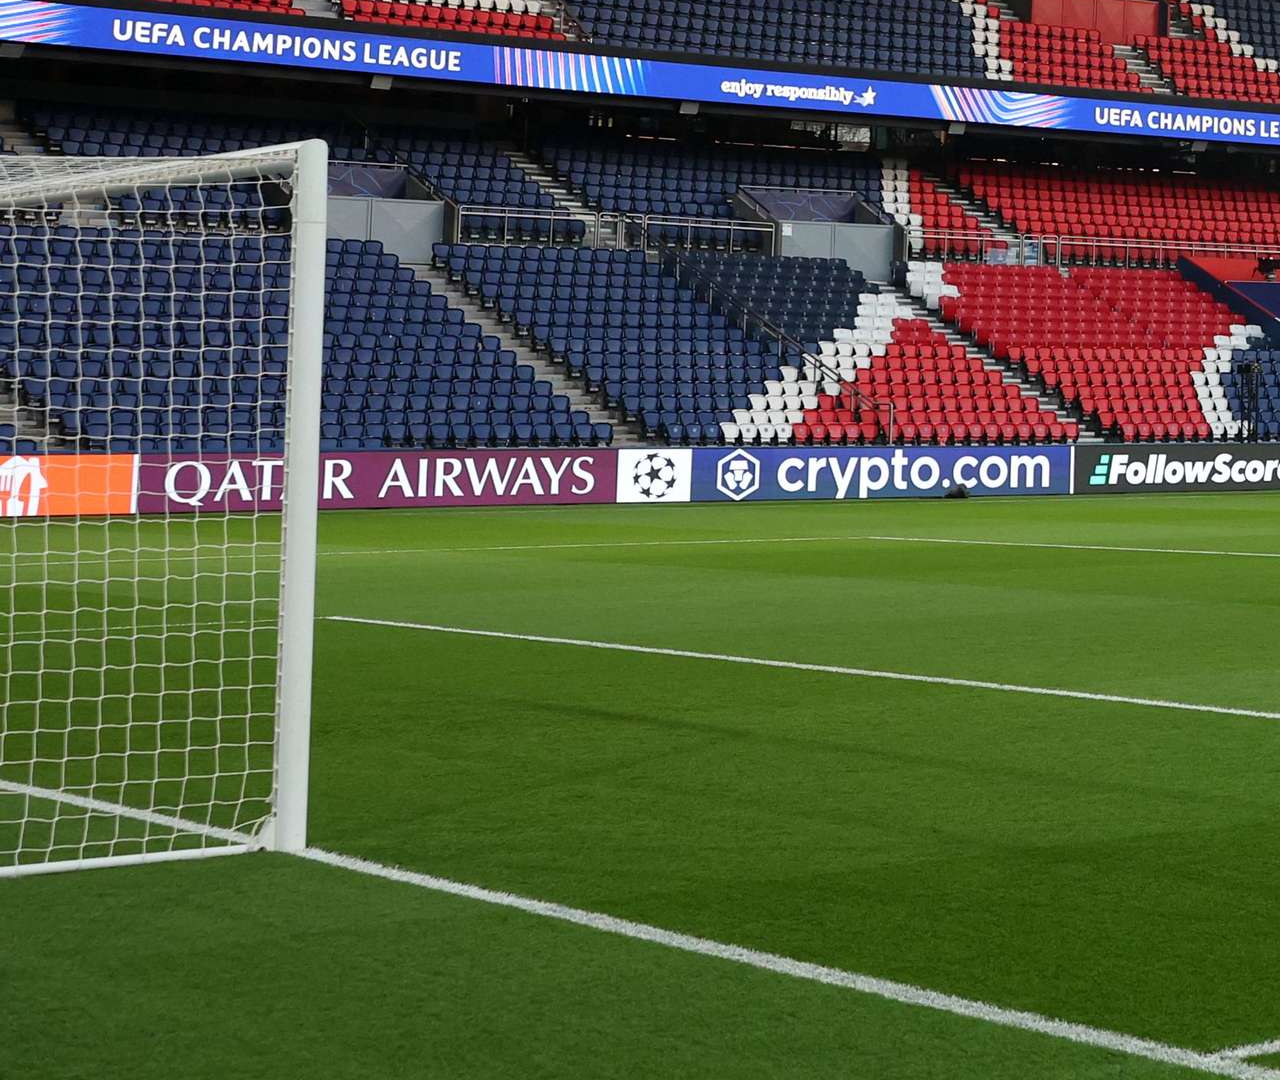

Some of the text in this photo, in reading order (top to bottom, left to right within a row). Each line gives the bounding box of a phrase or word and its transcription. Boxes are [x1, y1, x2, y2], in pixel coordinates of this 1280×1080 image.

[113, 19, 461, 72] UEFA CHAMPIONS LEAGUE
[720, 77, 854, 102] enjoy responsibly
[1095, 106, 1143, 128] UEFA
[1147, 111, 1256, 137] CHAMPIONS
[164, 456, 595, 506] QATR AIRWAYS
[777, 448, 1050, 499] crypto.com
